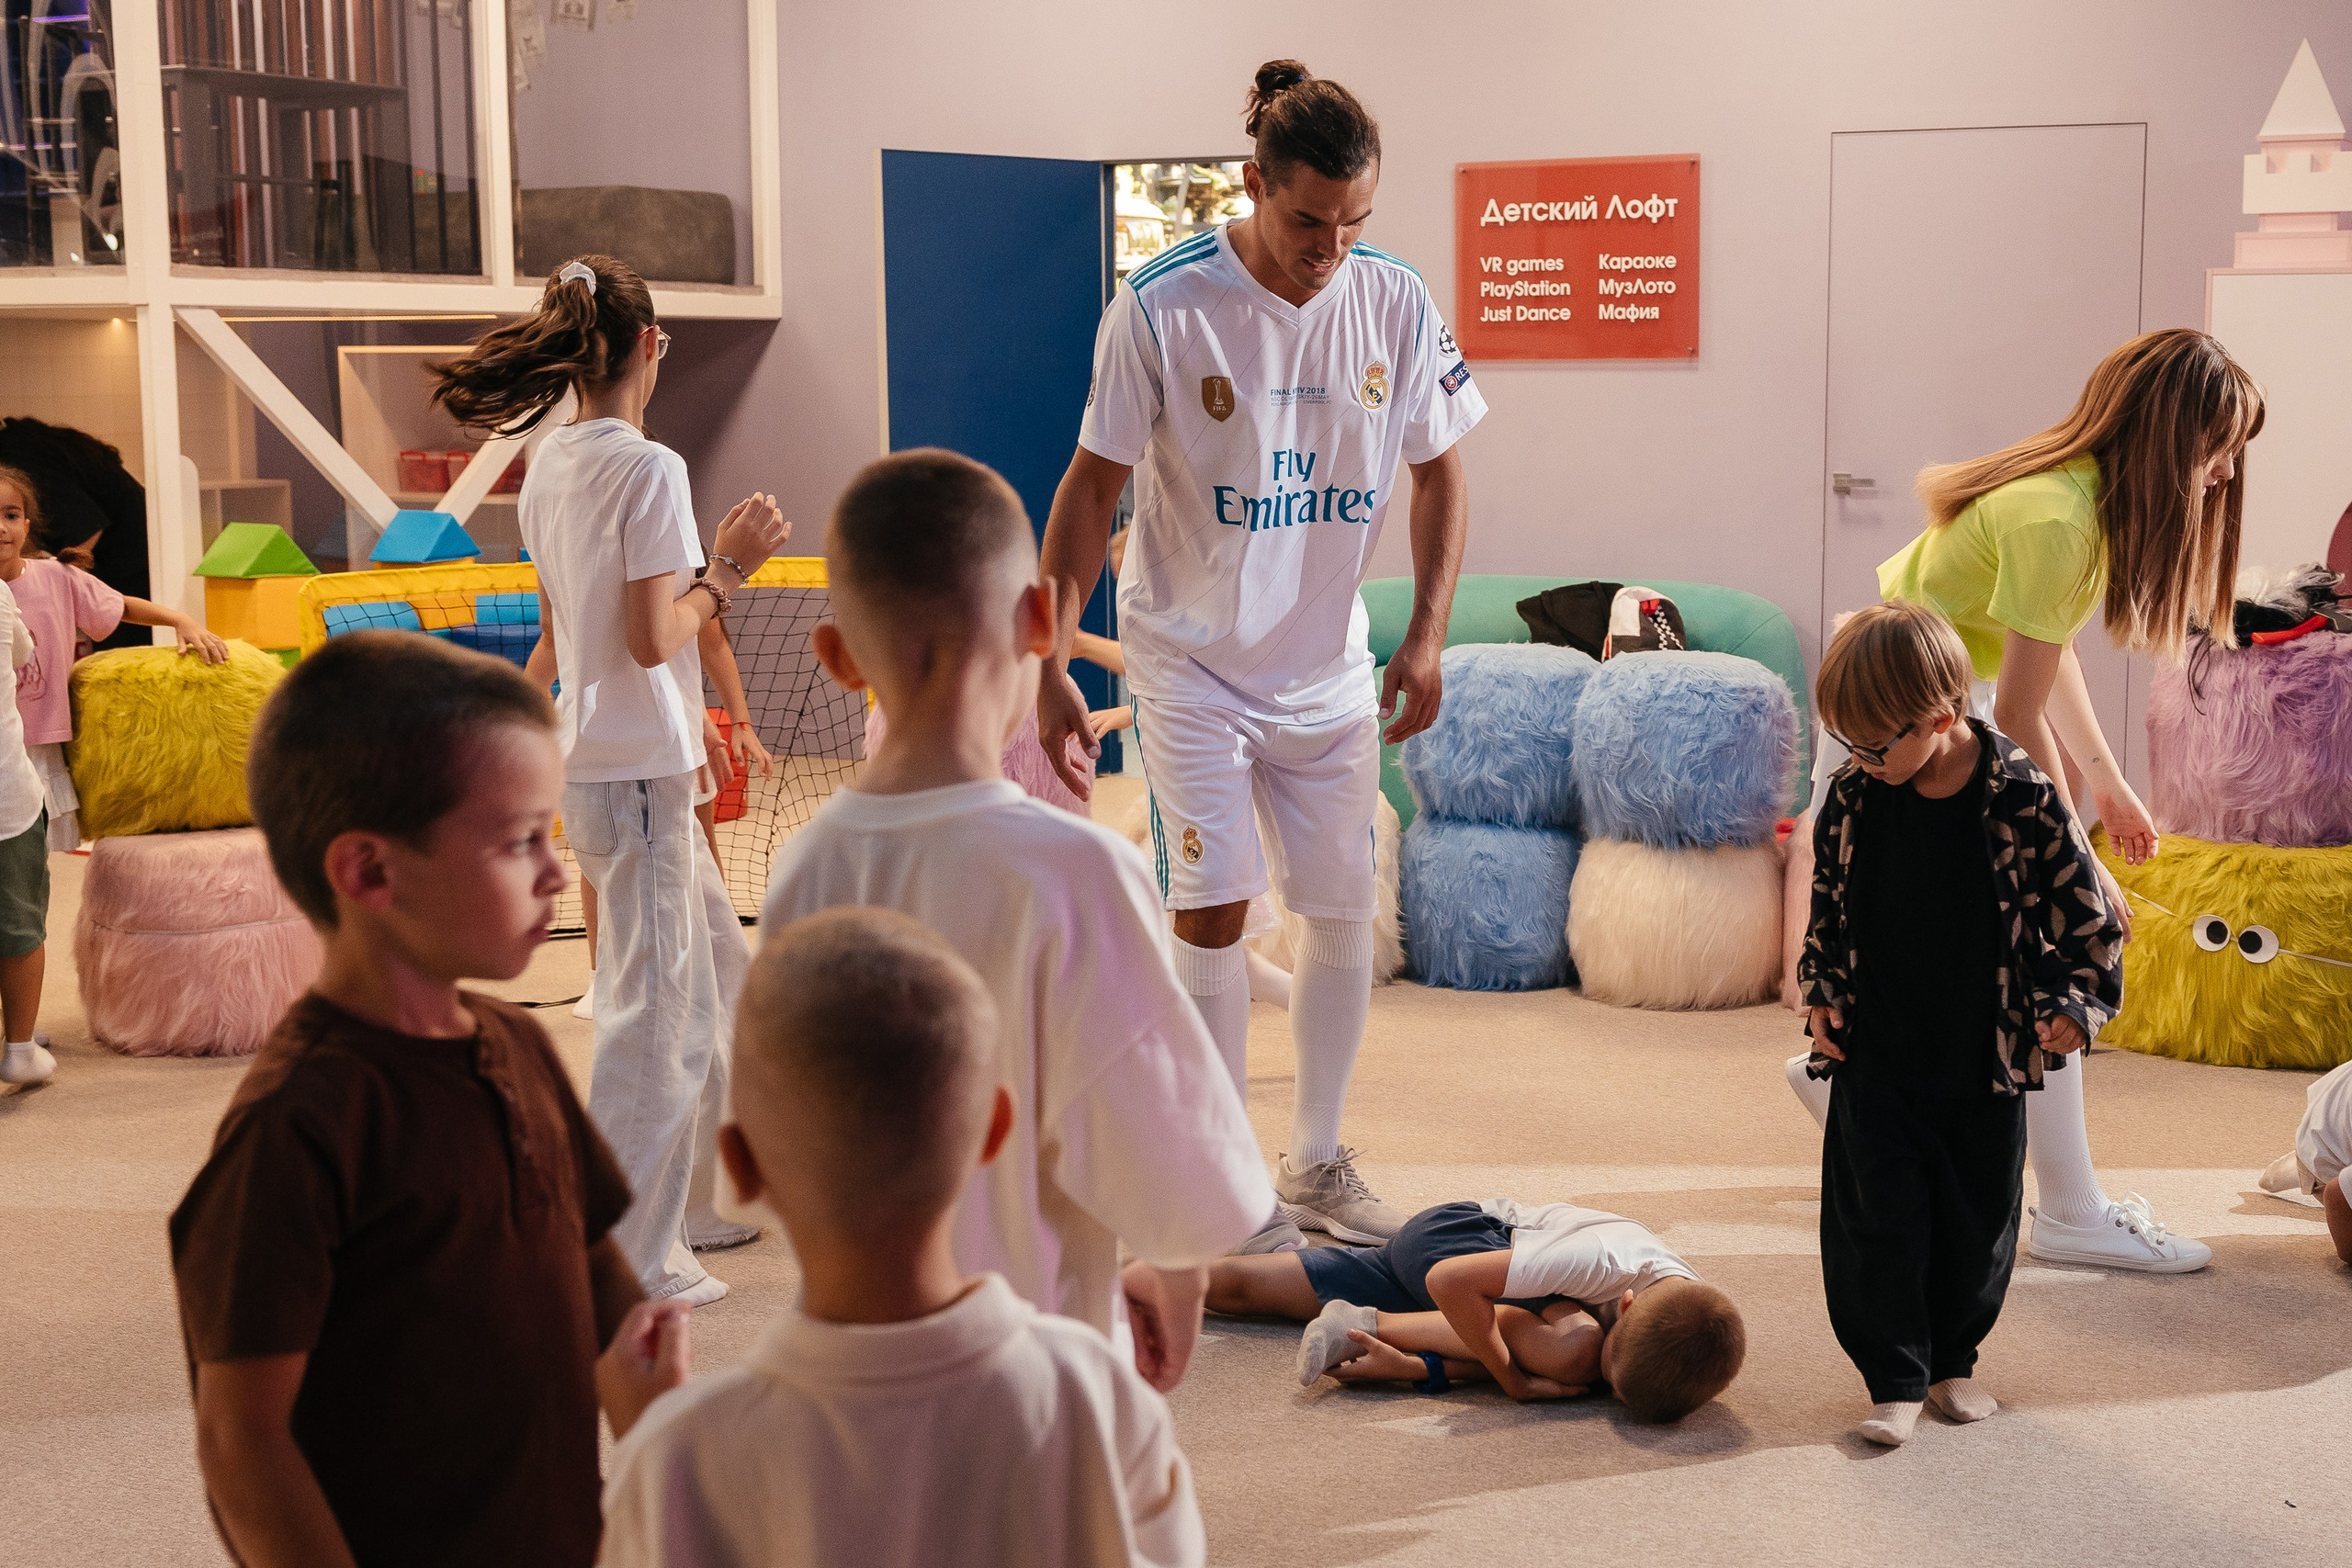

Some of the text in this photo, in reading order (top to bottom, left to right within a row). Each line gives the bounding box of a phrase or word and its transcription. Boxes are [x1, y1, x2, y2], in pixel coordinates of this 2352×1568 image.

[1480, 193, 1679, 227] Детский Лофт
[1480, 256, 1565, 276] VR games
[1599, 254, 1677, 272] Караоке
[1480, 280, 1571, 299] PlayStation
[1599, 278, 1677, 298] МузЛото
[1480, 305, 1571, 322] Just Dance
[1599, 303, 1660, 322] Мафия
[1272, 448, 1317, 483] Fly
[1212, 481, 1376, 532] Emirates
